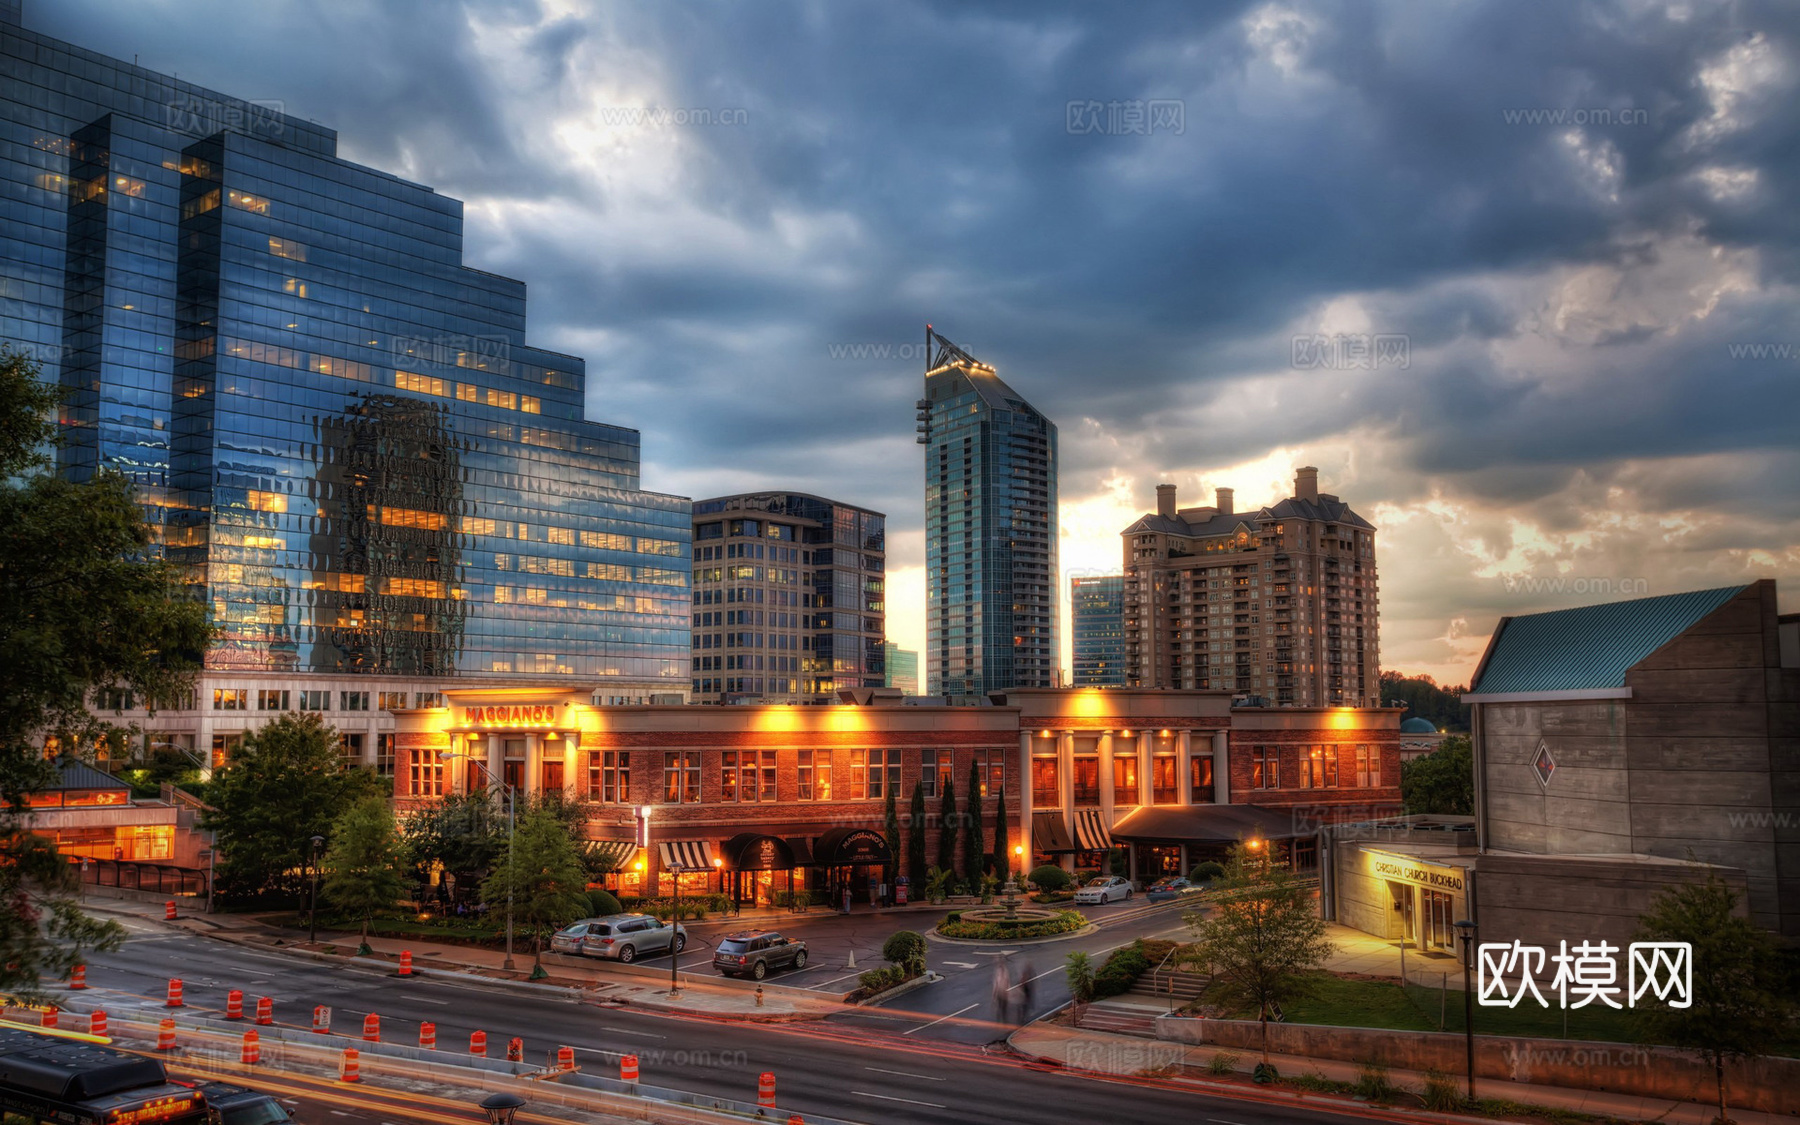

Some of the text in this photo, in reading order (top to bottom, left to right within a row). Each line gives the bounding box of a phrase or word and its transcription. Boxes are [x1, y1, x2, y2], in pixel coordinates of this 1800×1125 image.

[465, 706, 554, 723] MAGGIANO'S
[842, 832, 885, 850] MAGGIANO'S
[1375, 861, 1462, 890] CHRISTIAN CHURCH BUCKHEAD
